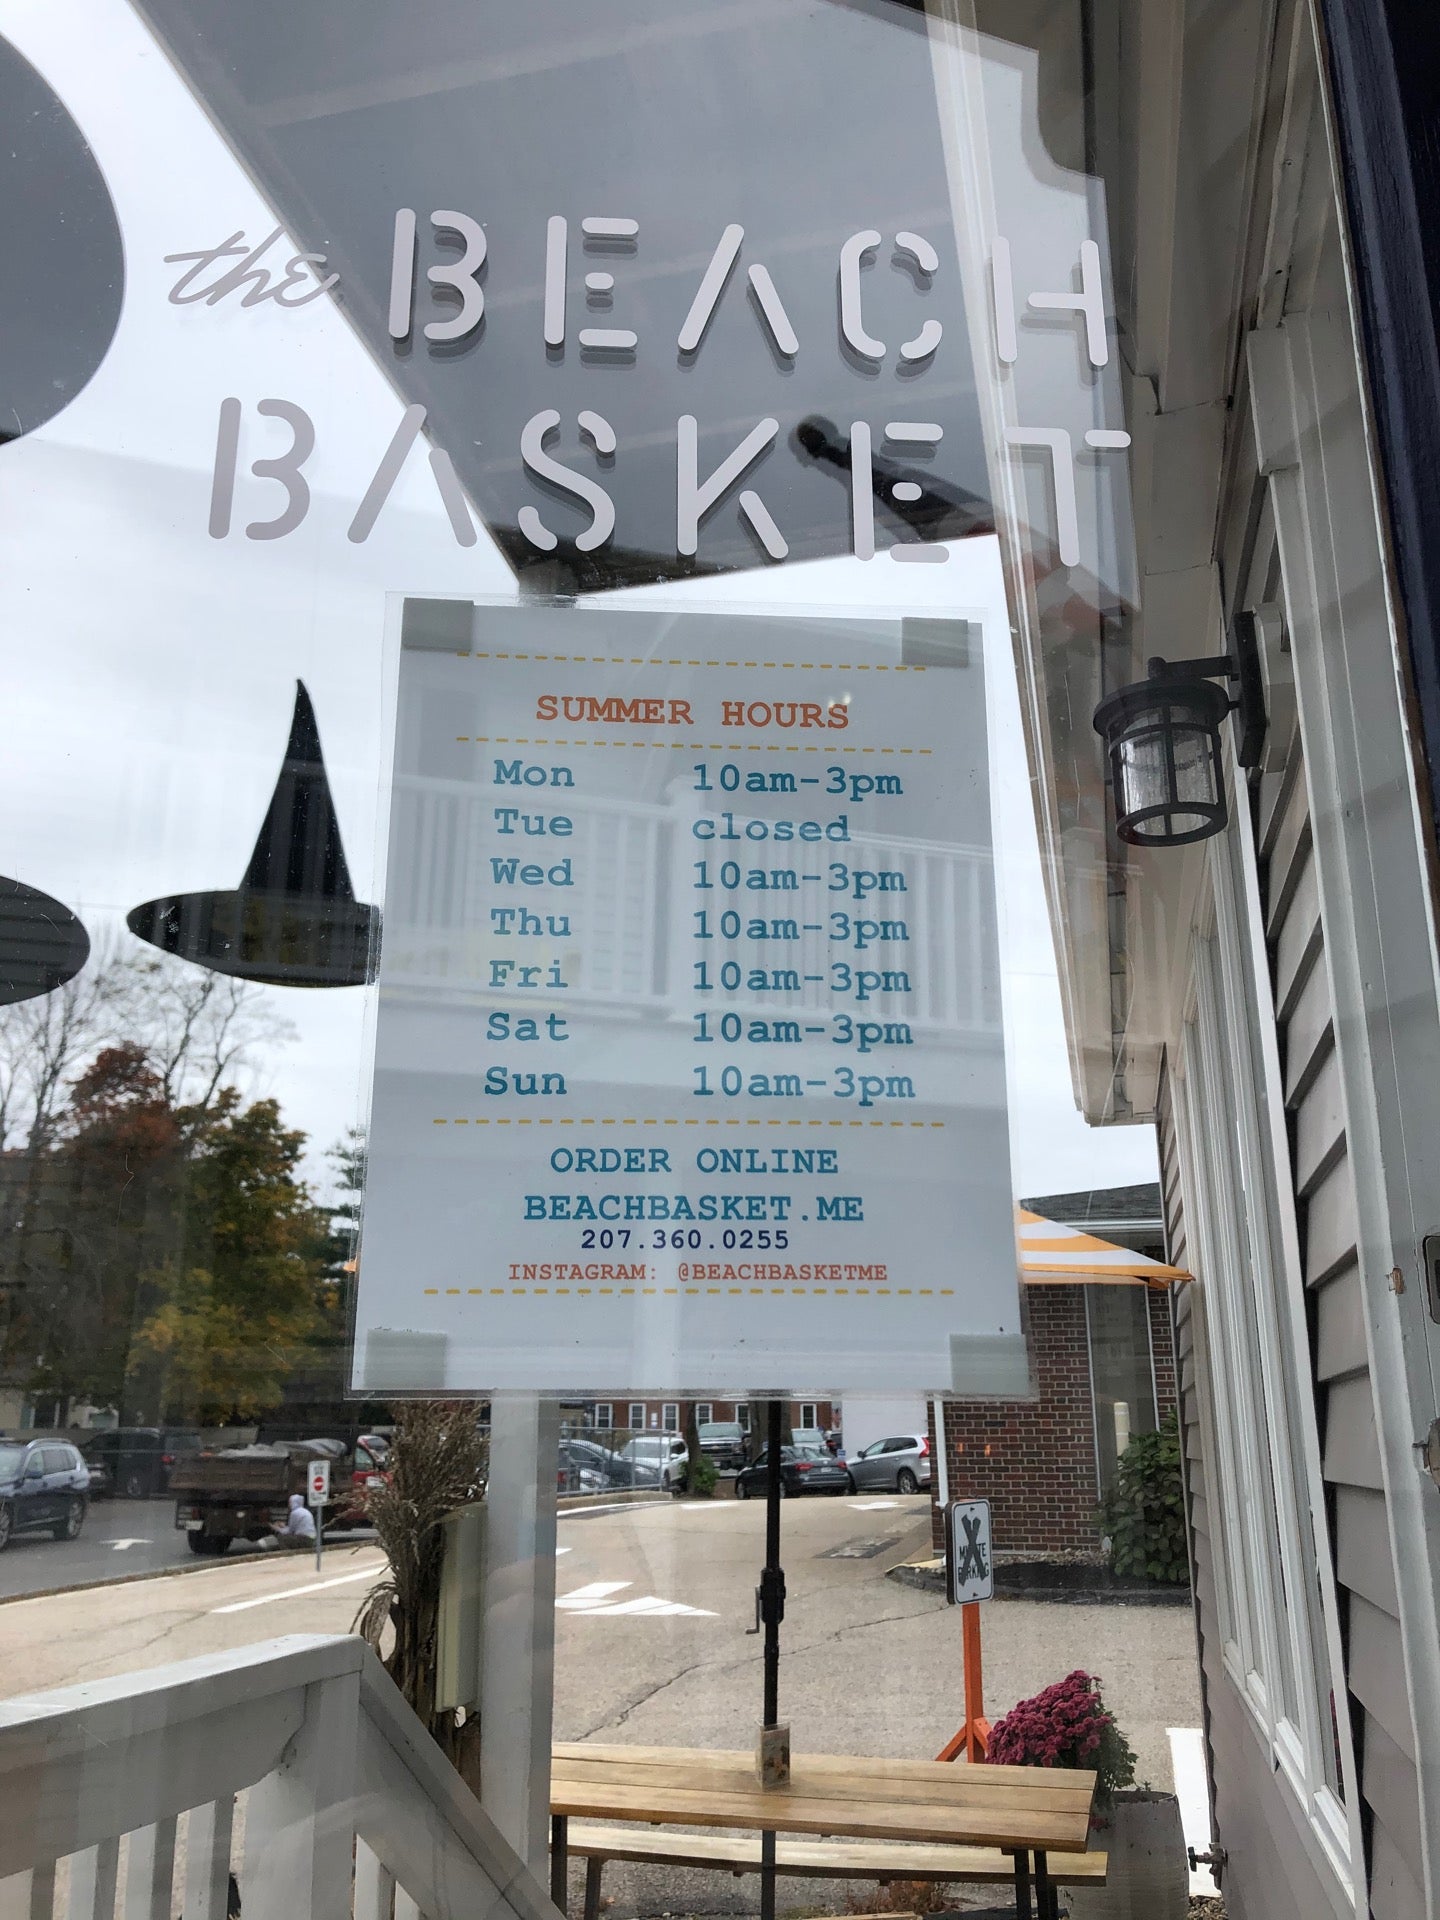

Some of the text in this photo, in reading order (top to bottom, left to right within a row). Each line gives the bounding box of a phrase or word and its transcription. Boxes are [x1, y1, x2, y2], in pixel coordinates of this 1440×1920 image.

[164, 207, 1109, 367] the BEACH
[208, 396, 1132, 568] BASKET
[536, 695, 850, 729] SUMMER HOURS
[493, 759, 904, 801] Mon 10am-3pm
[494, 808, 852, 843] Tue closed
[489, 857, 908, 899] Wed 10am-3pm
[490, 907, 910, 949] Thu 10am-3pm
[488, 959, 912, 1000] Fri 10am-3pm
[486, 1012, 914, 1053] Sat 10am-3pm
[484, 1065, 916, 1107] Sun 10am-3pm
[550, 1147, 839, 1175] ORDER ONLINE
[523, 1194, 865, 1222] BEACHBASKET.ME
[581, 1229, 790, 1250] 207.360.0255
[508, 1263, 888, 1282] INSTAGRAM: @BEACHBASKETME
